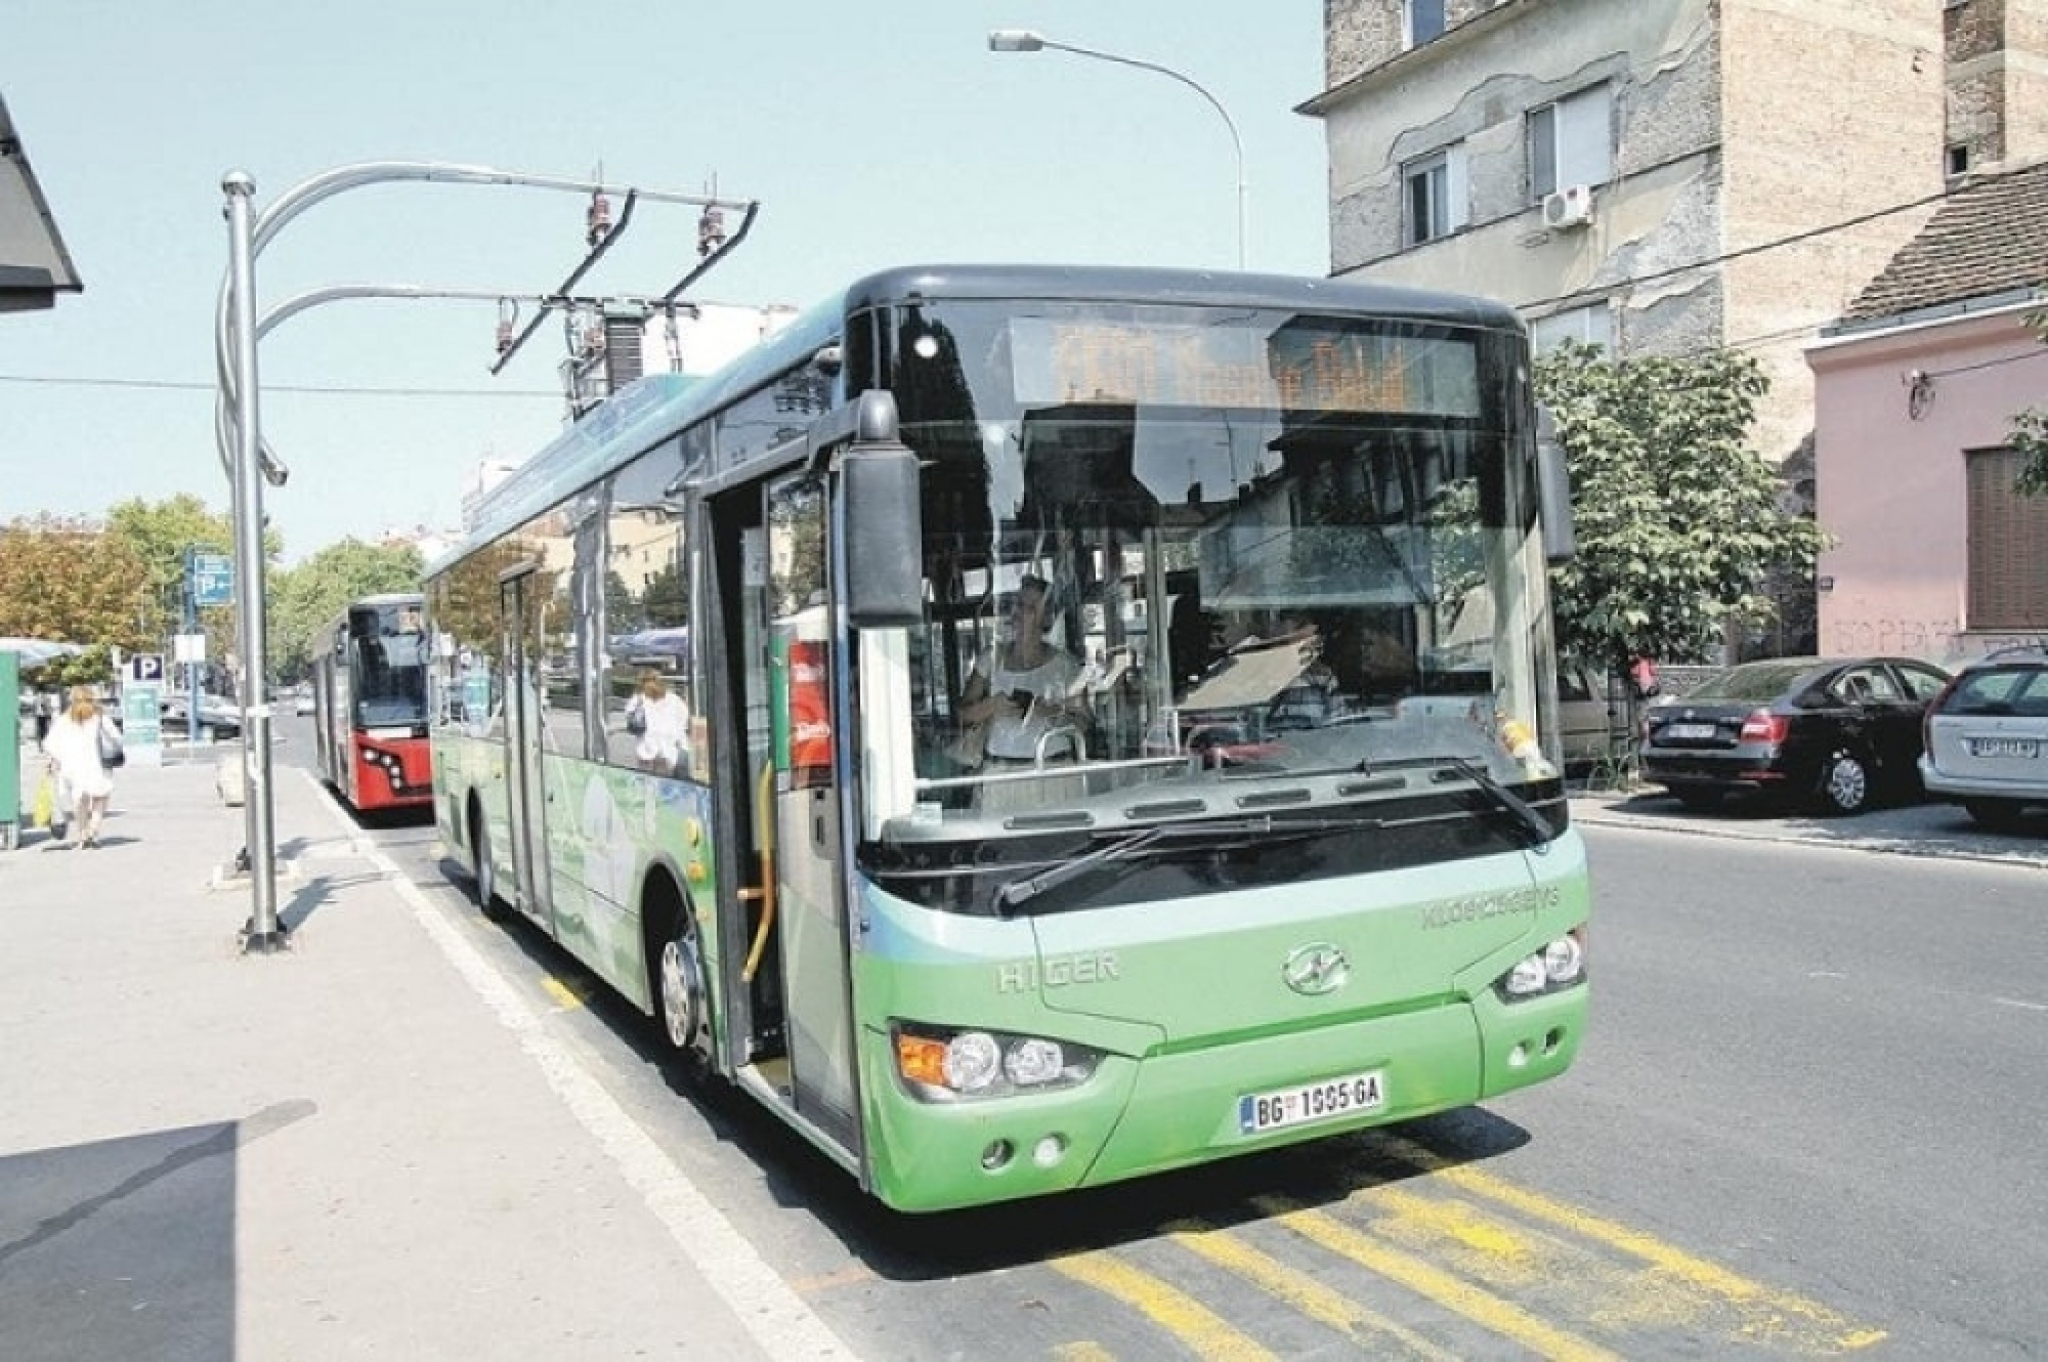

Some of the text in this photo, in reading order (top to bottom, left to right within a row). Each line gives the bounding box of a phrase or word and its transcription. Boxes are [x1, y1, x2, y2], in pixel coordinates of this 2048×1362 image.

[140, 656, 158, 680] P
[995, 950, 1120, 994] HIGER
[1257, 1096, 1283, 1127] BG
